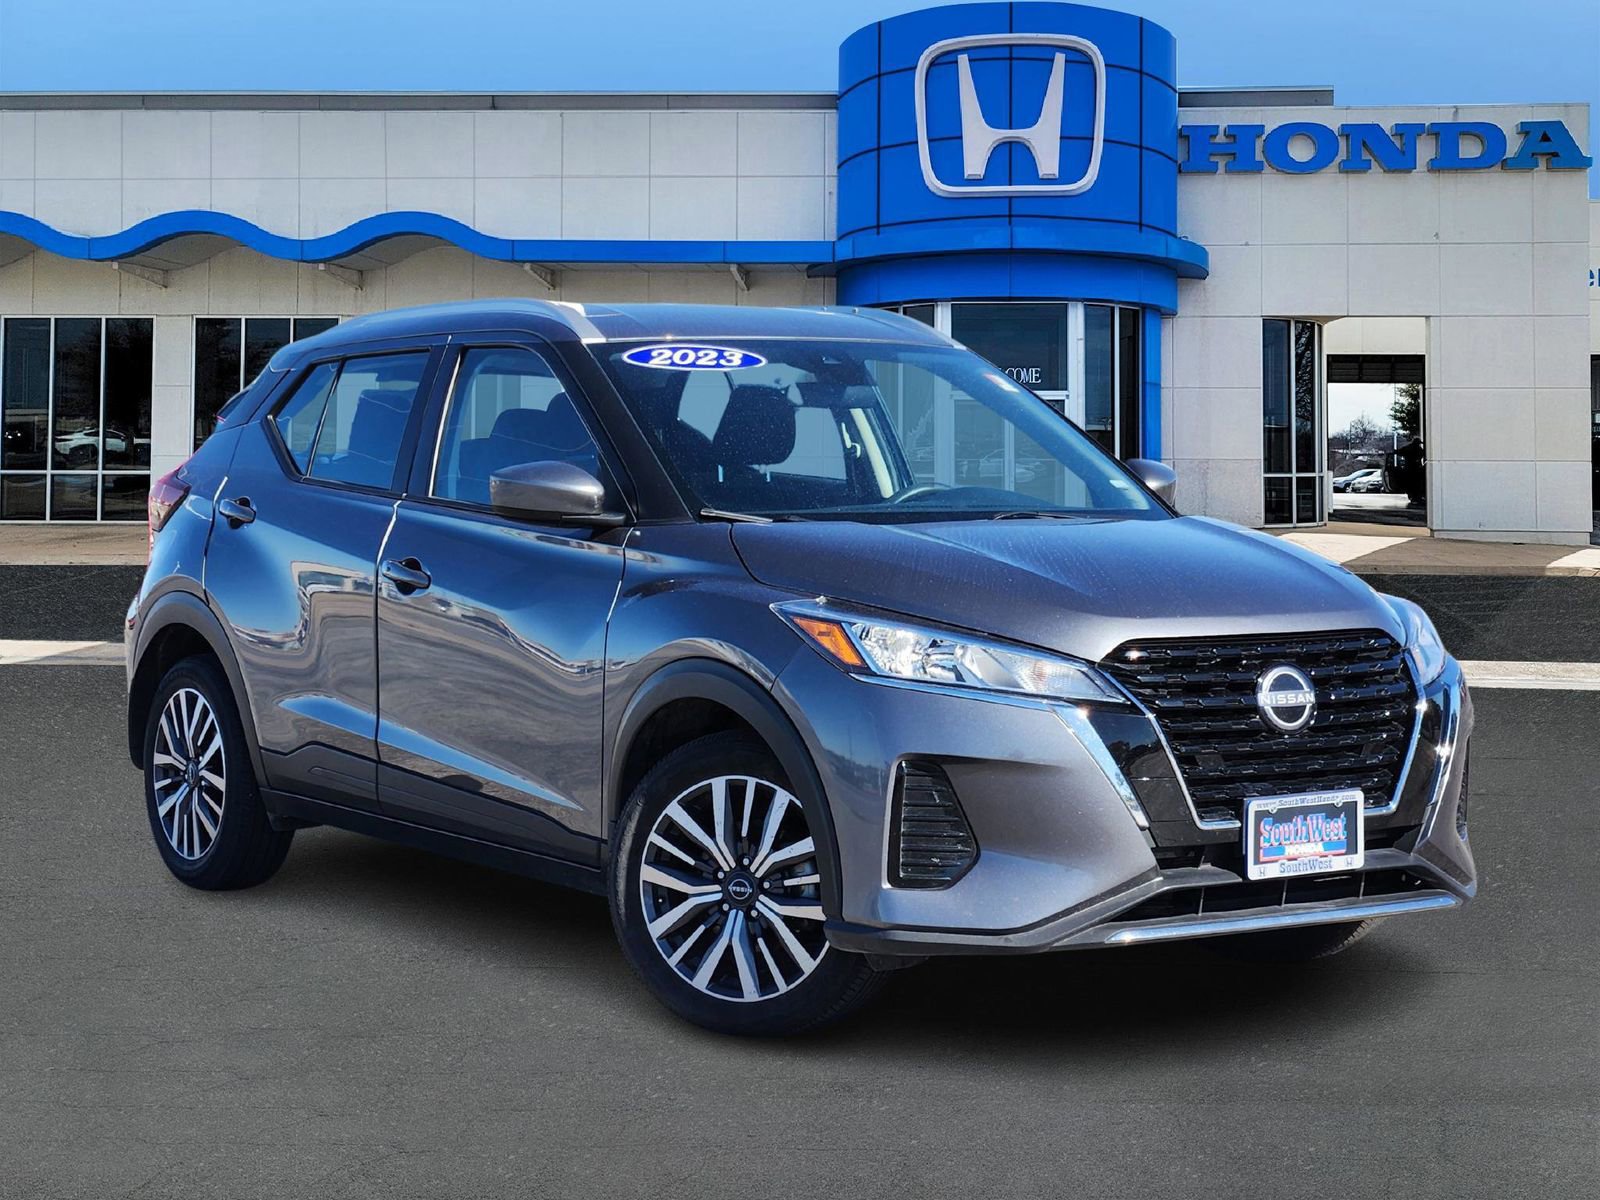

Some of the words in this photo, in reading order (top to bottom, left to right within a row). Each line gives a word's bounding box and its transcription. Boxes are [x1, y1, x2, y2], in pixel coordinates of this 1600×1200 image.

[1179, 120, 1593, 173] HONDA
[648, 349, 744, 367] 2023
[1260, 692, 1314, 705] NISSAN
[1260, 811, 1347, 848] SouthWest
[1279, 858, 1334, 875] SouthWest
